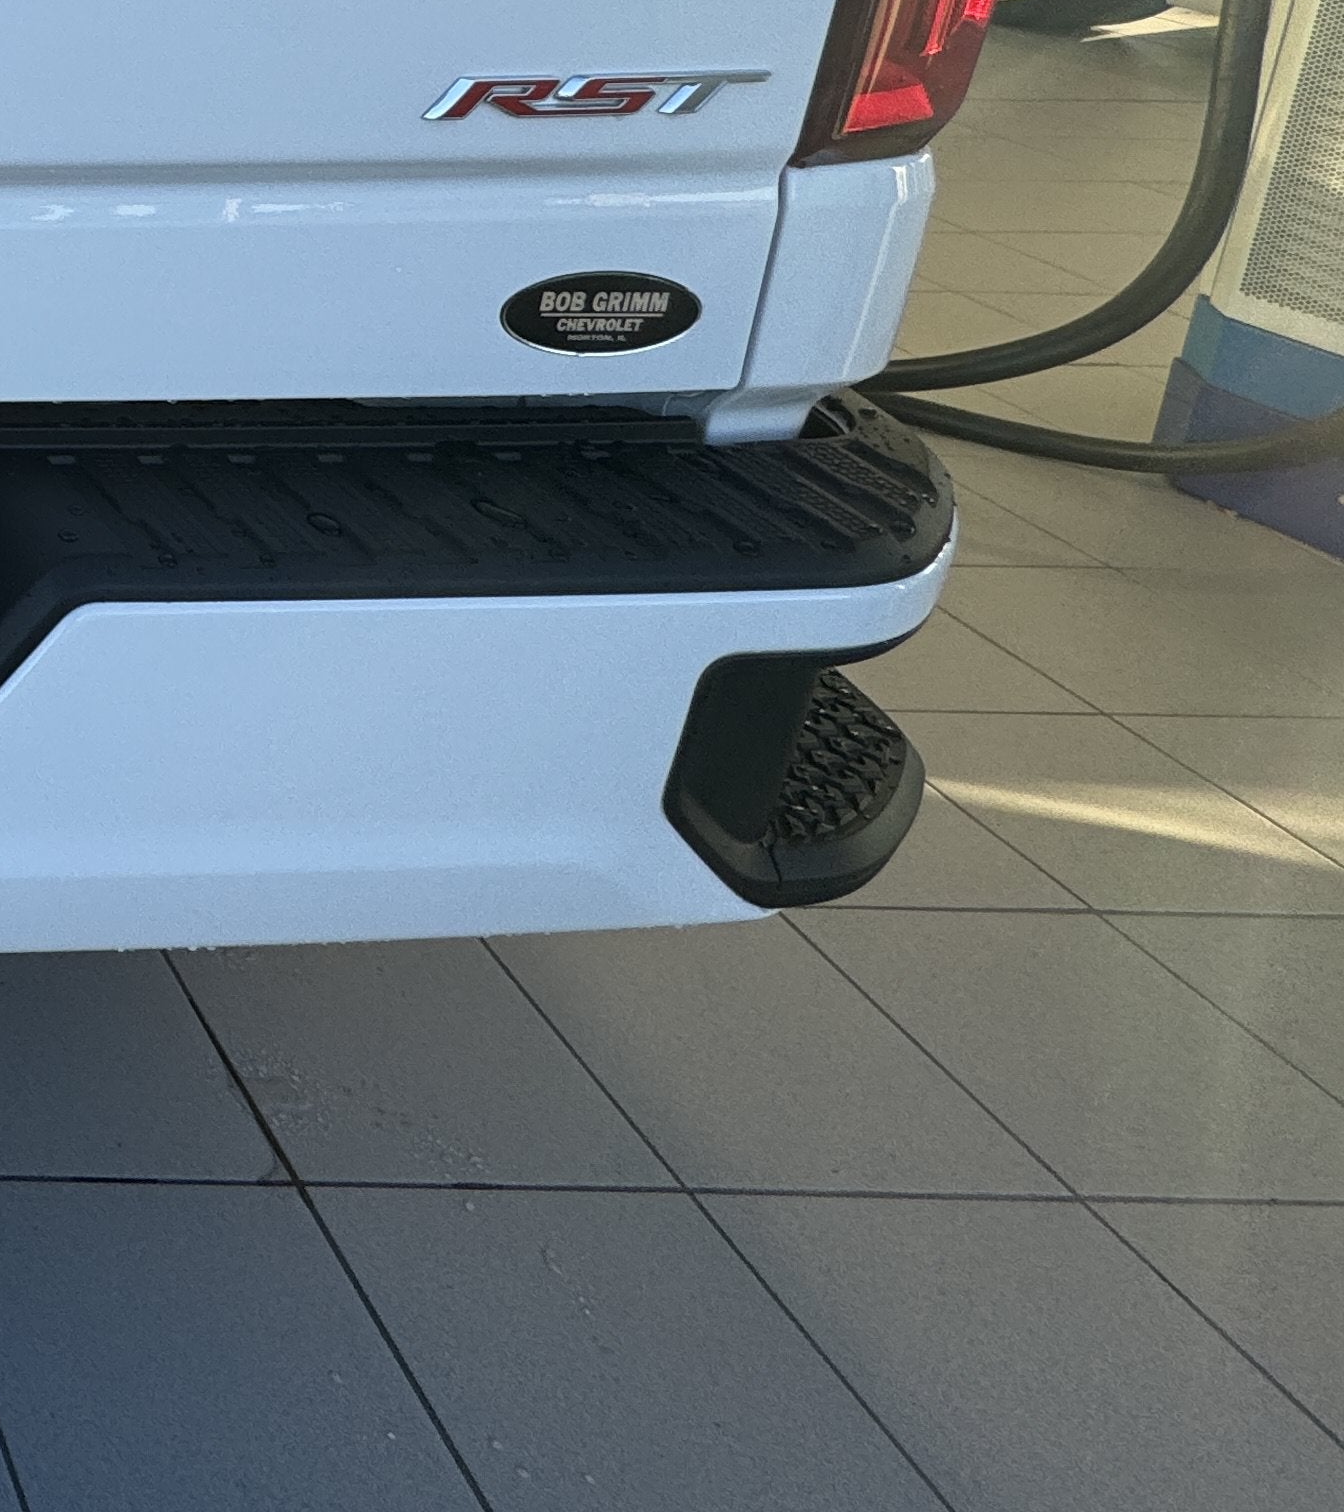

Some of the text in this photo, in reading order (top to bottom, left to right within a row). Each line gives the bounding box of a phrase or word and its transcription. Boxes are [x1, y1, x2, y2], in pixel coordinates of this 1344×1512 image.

[421, 69, 772, 120] RST
[539, 291, 670, 313] BOB GRIMM
[556, 318, 644, 332] CHEVROLET
